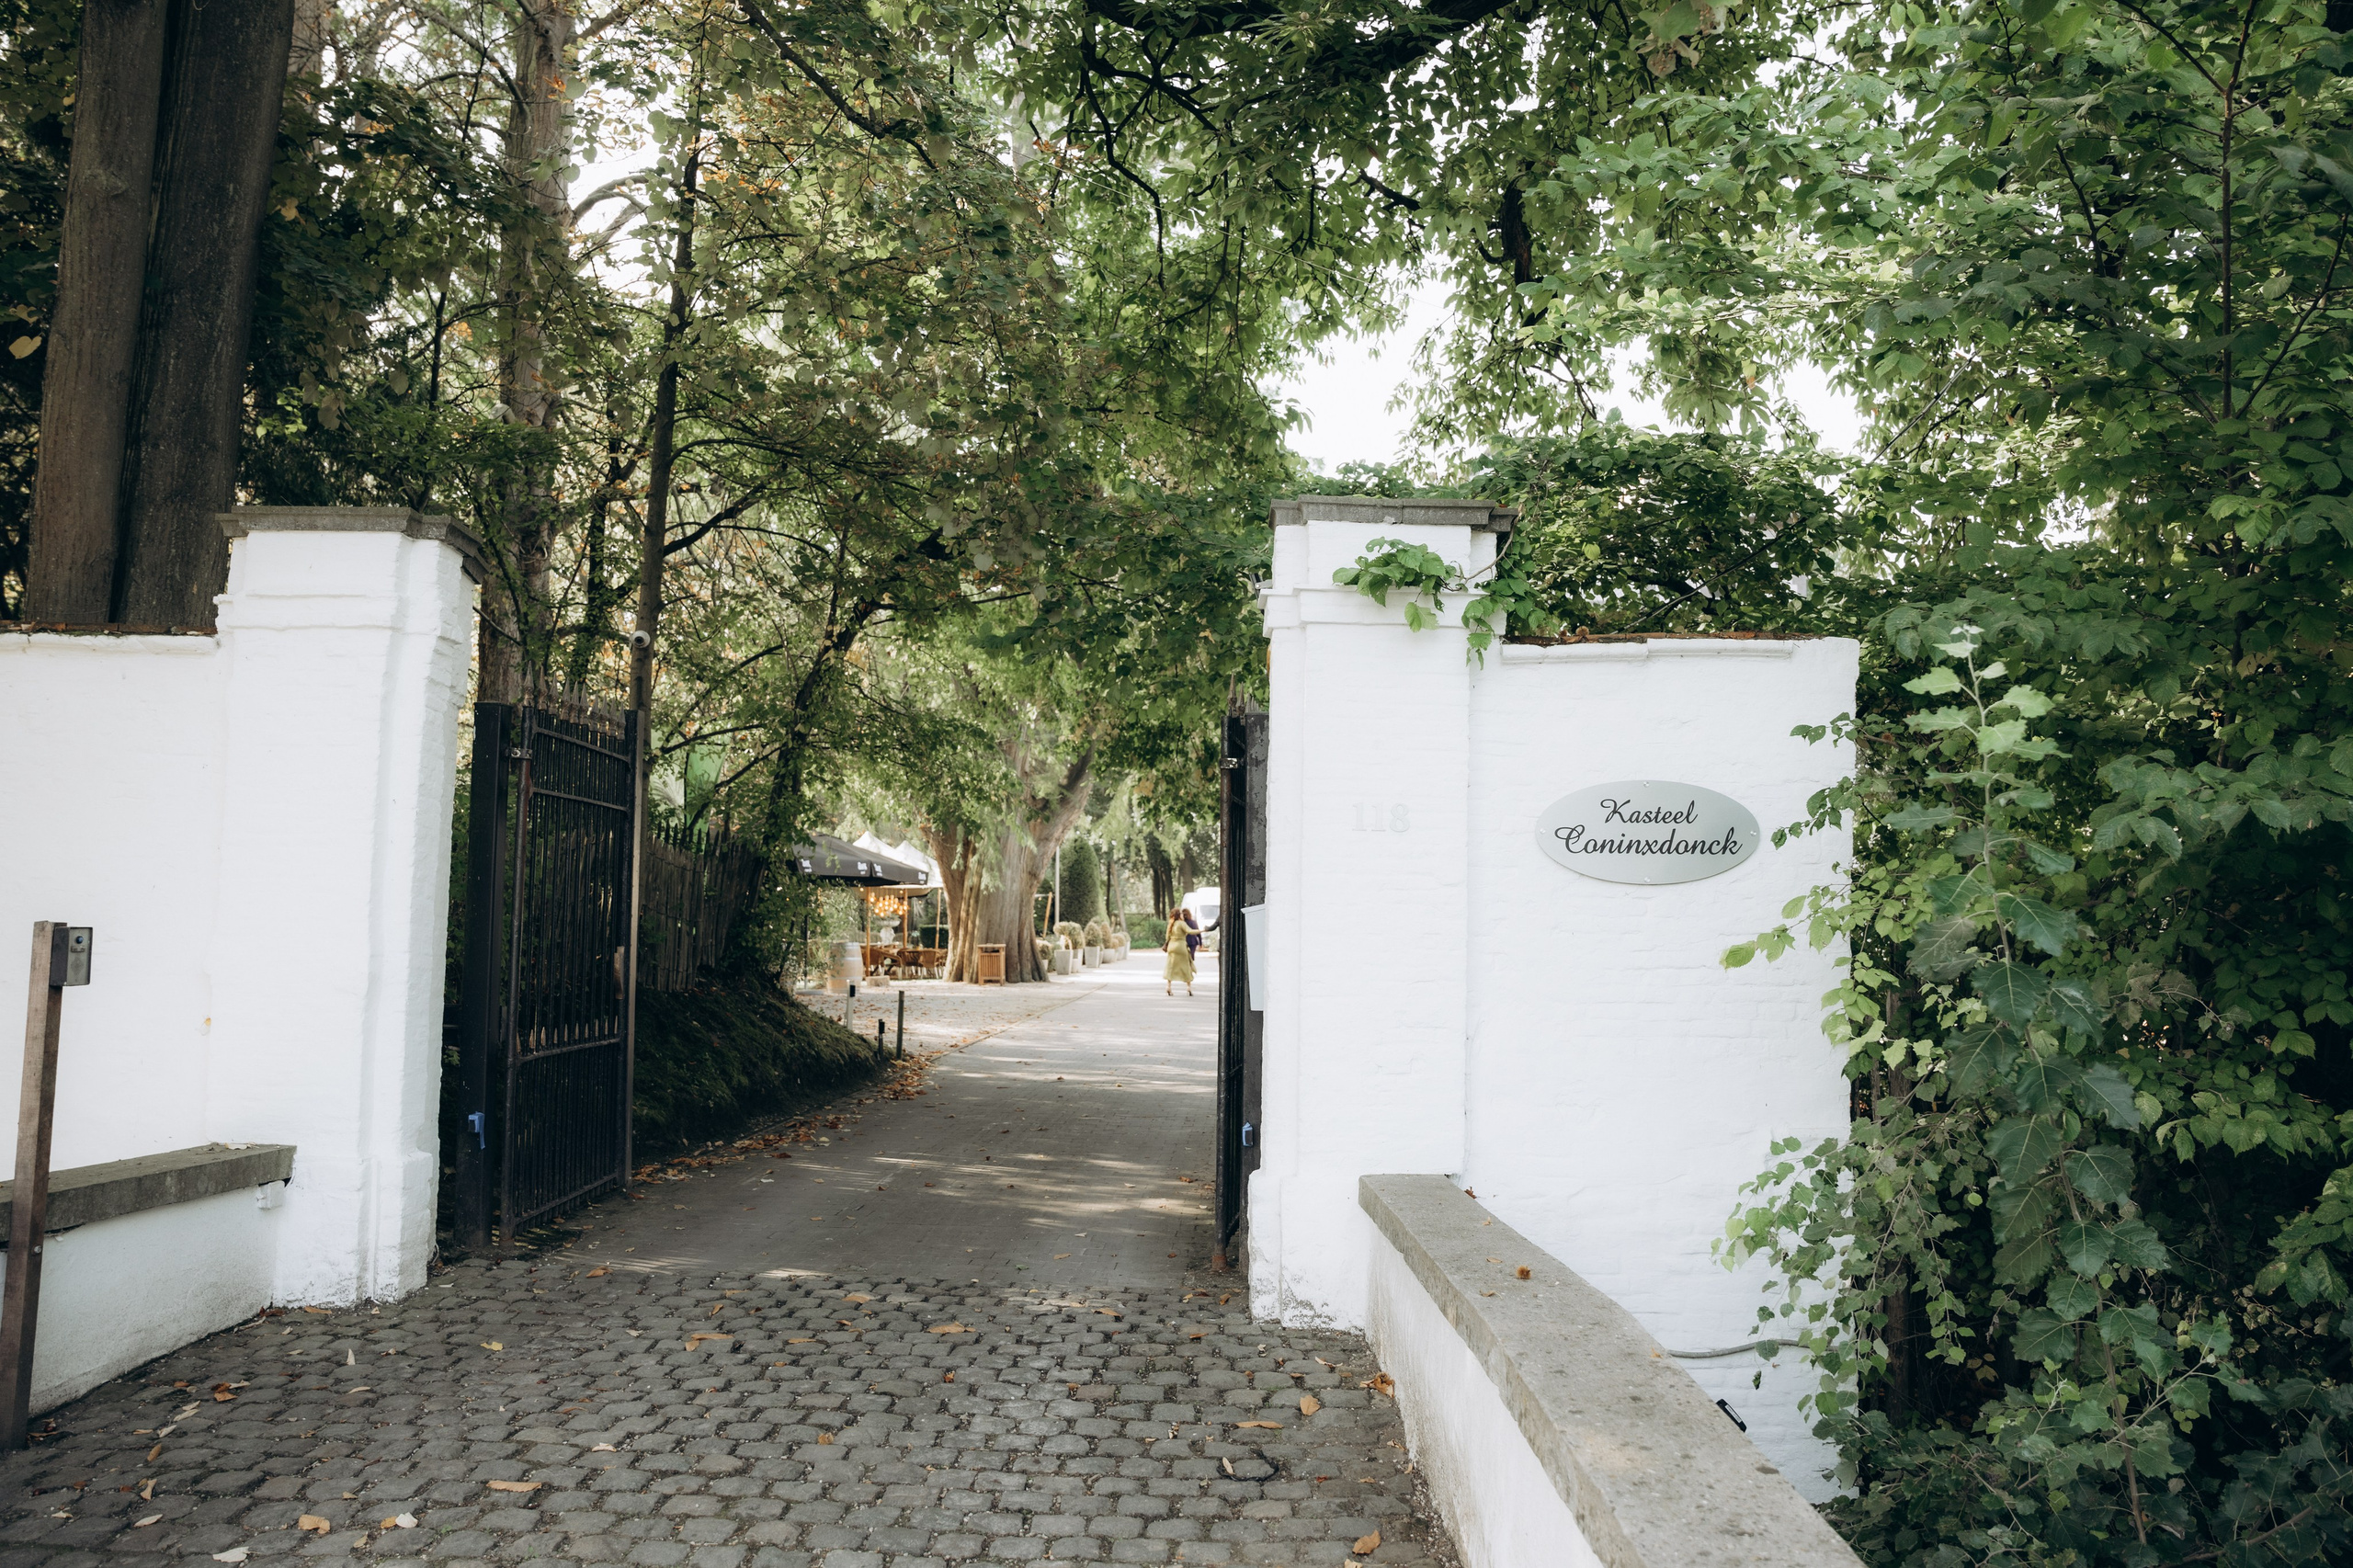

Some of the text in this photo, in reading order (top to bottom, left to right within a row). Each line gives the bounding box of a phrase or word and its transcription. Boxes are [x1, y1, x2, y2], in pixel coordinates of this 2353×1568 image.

[1352, 802, 1411, 834] 118
[1600, 799, 1699, 824] Kasteel
[1554, 824, 1744, 857] Coninxdonck
